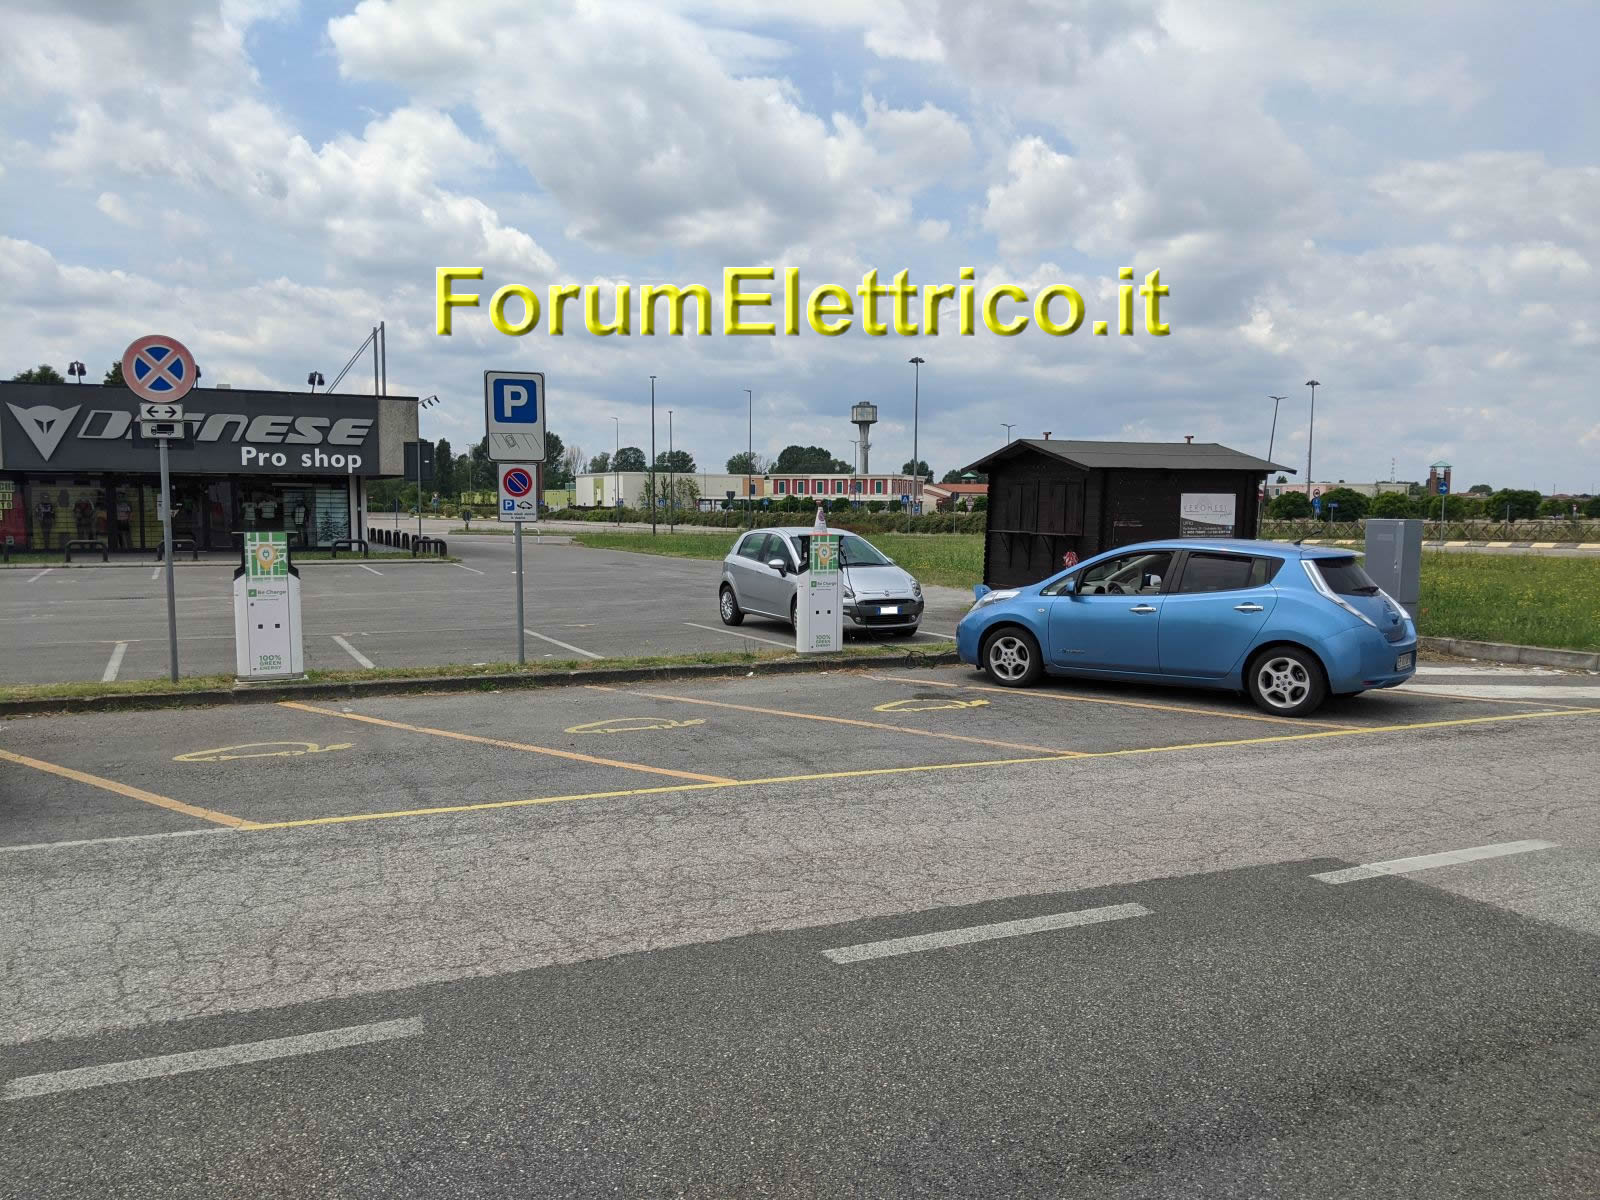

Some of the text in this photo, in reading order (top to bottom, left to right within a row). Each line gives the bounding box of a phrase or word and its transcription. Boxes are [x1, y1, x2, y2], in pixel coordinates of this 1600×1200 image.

[504, 385, 528, 417] P
[77, 408, 374, 446] DNESE
[241, 447, 362, 473] Pro shop
[505, 501, 513, 510] P
